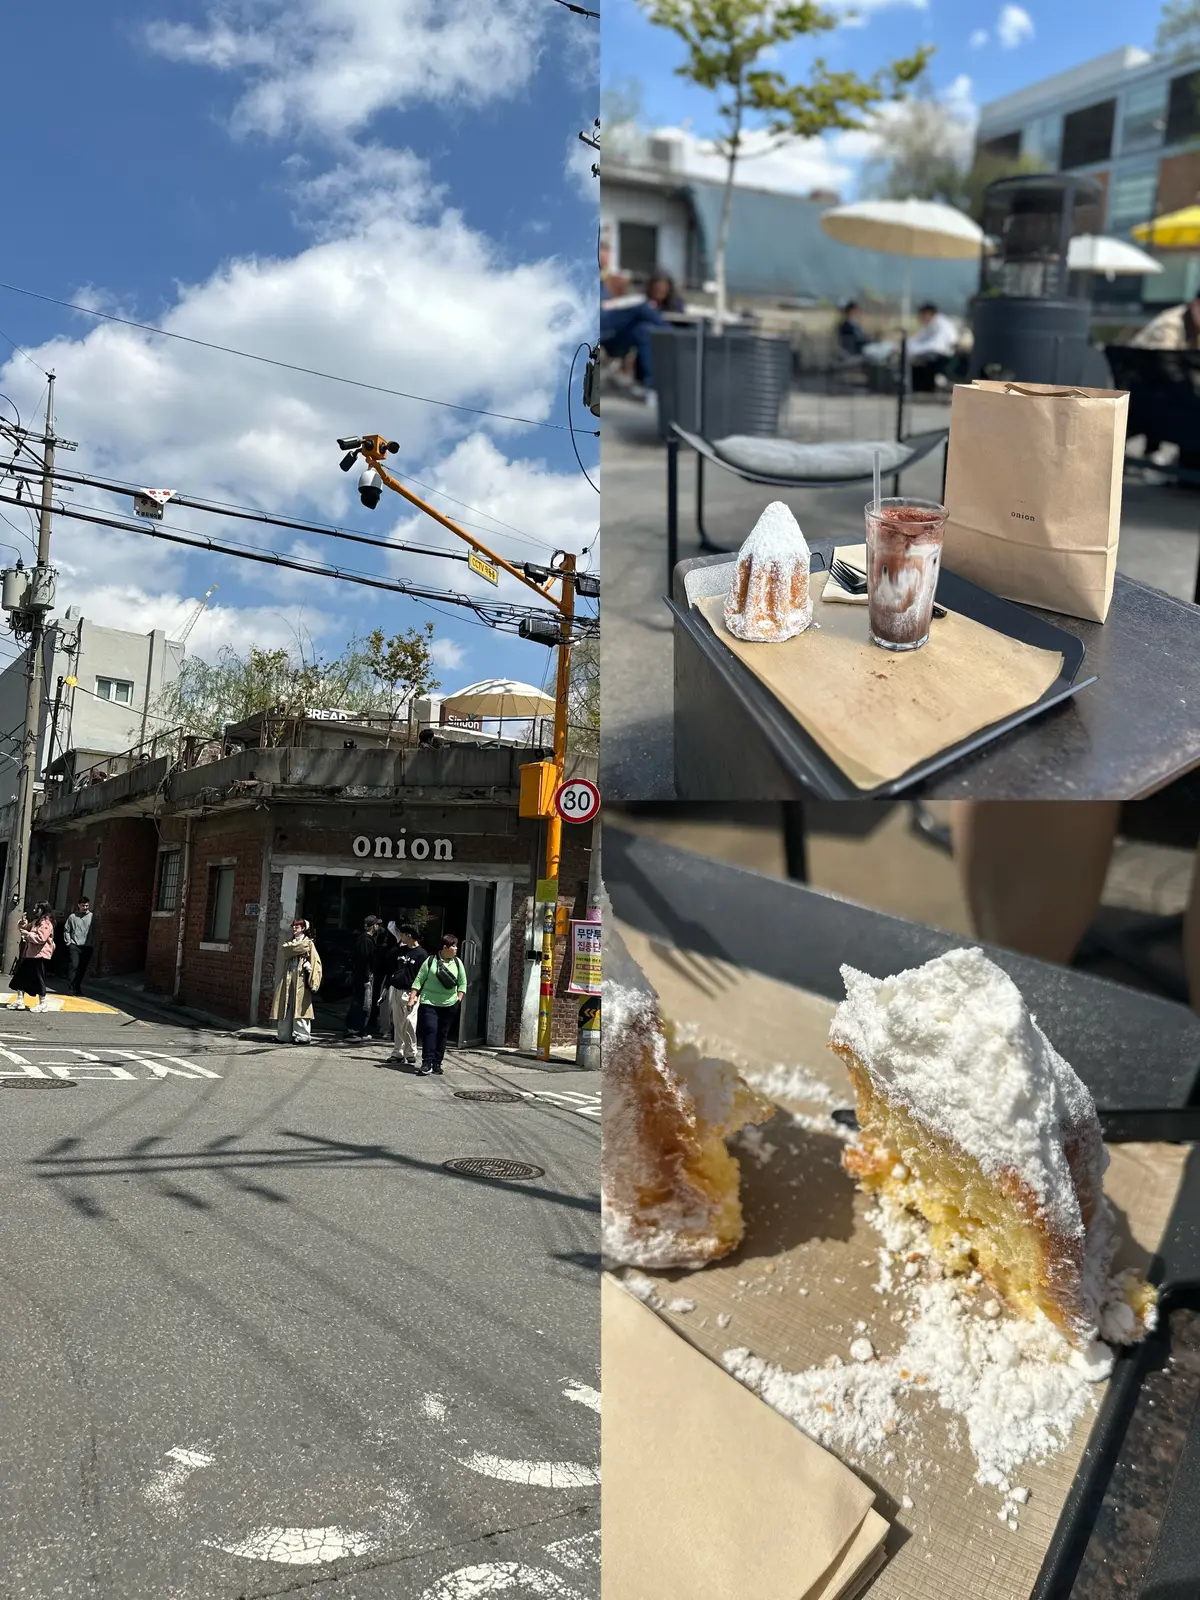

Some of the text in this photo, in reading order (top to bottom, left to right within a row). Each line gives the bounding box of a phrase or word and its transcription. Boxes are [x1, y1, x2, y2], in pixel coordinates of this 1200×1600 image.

[1010, 511, 1035, 522] onion
[472, 557, 484, 571] CCTV
[304, 708, 348, 723] BREAD
[564, 790, 590, 811] 30
[352, 827, 454, 861] onion
